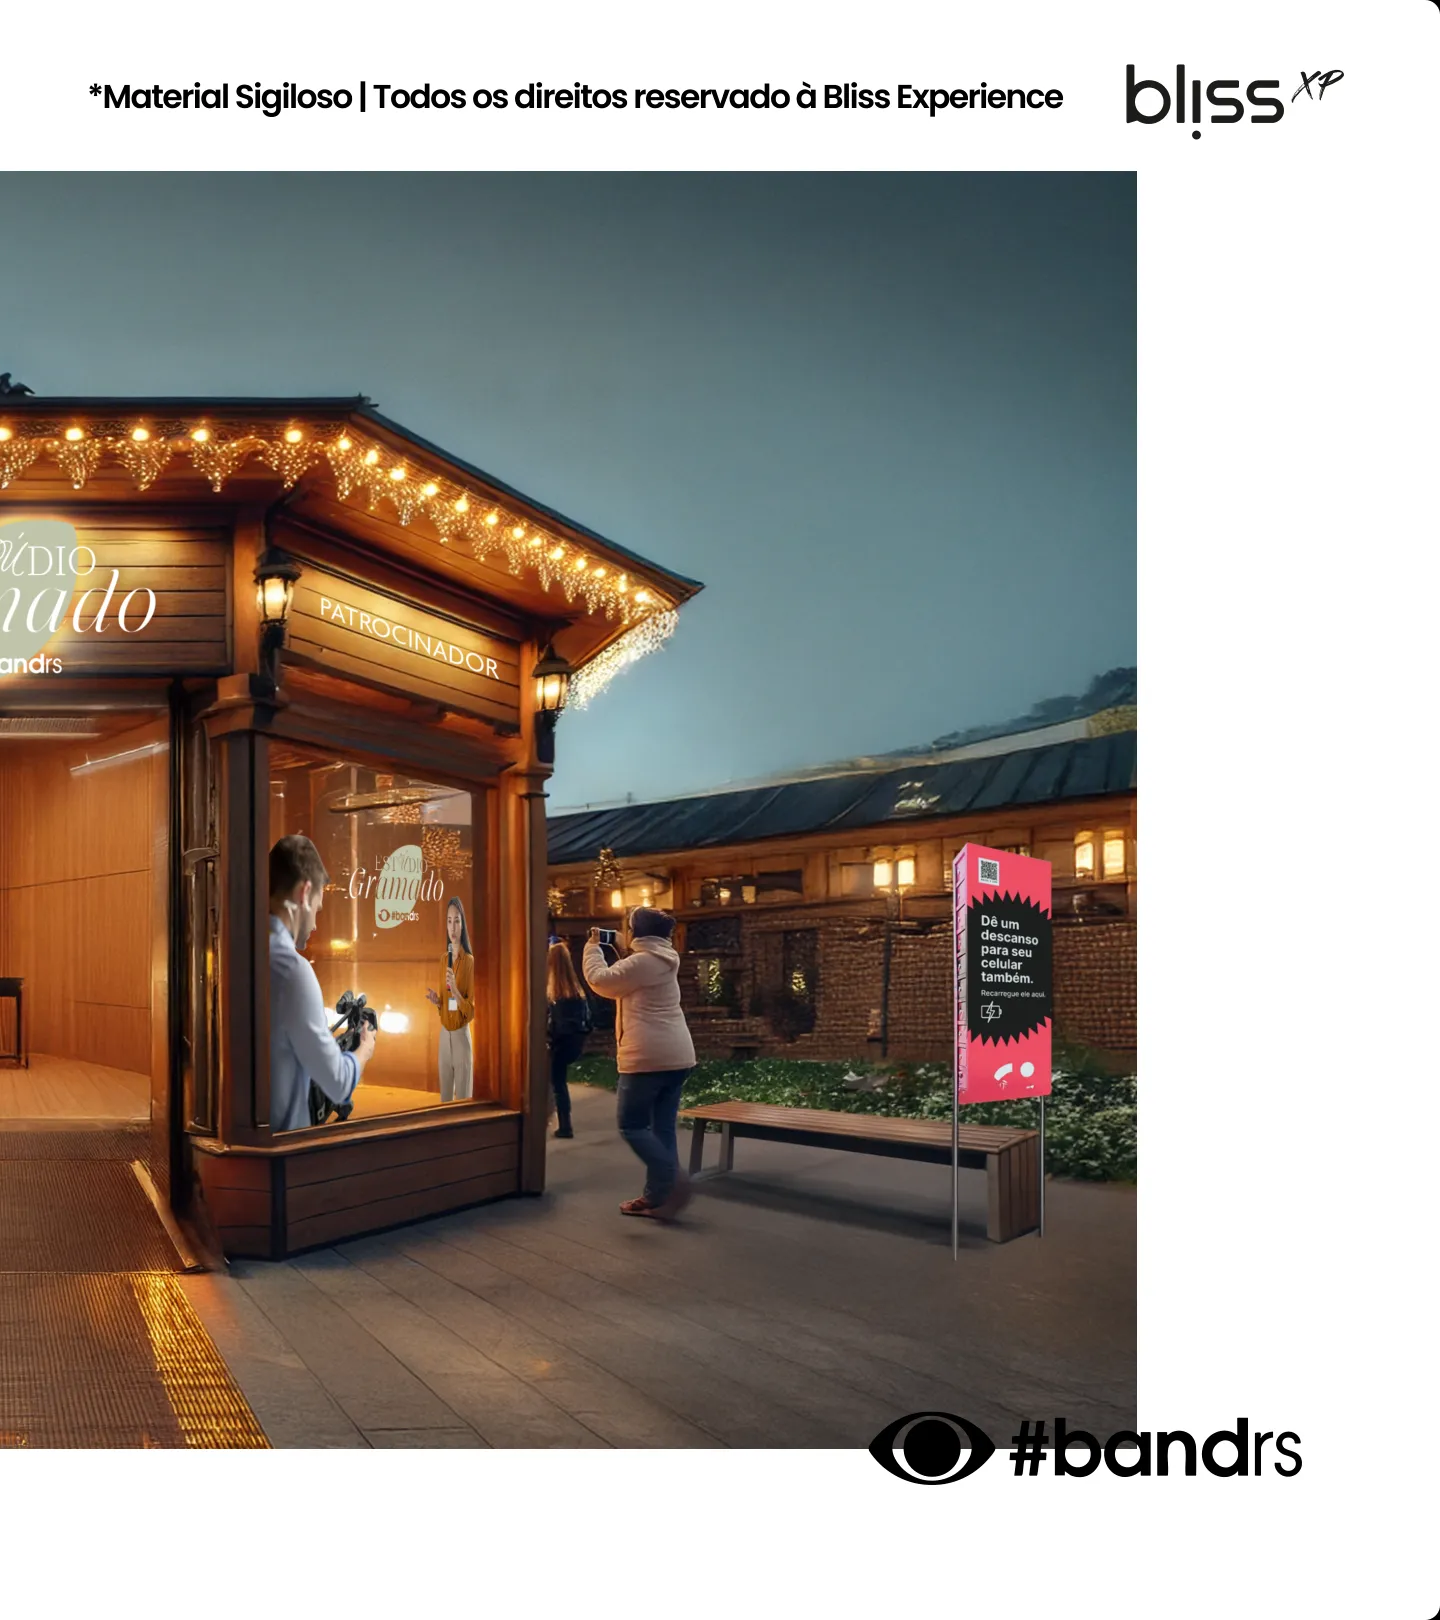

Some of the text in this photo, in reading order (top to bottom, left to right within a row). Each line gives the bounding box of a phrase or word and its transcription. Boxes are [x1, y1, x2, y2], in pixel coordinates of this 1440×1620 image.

[321, 597, 499, 679] PATROCINADOR
[349, 867, 444, 902] Gramado
[981, 914, 1020, 930] Dê um
[981, 929, 1039, 946] descanso
[981, 945, 1033, 958] para seu
[981, 958, 1023, 970] celular
[981, 971, 1034, 984] também.
[981, 990, 1019, 999] Recarregue
